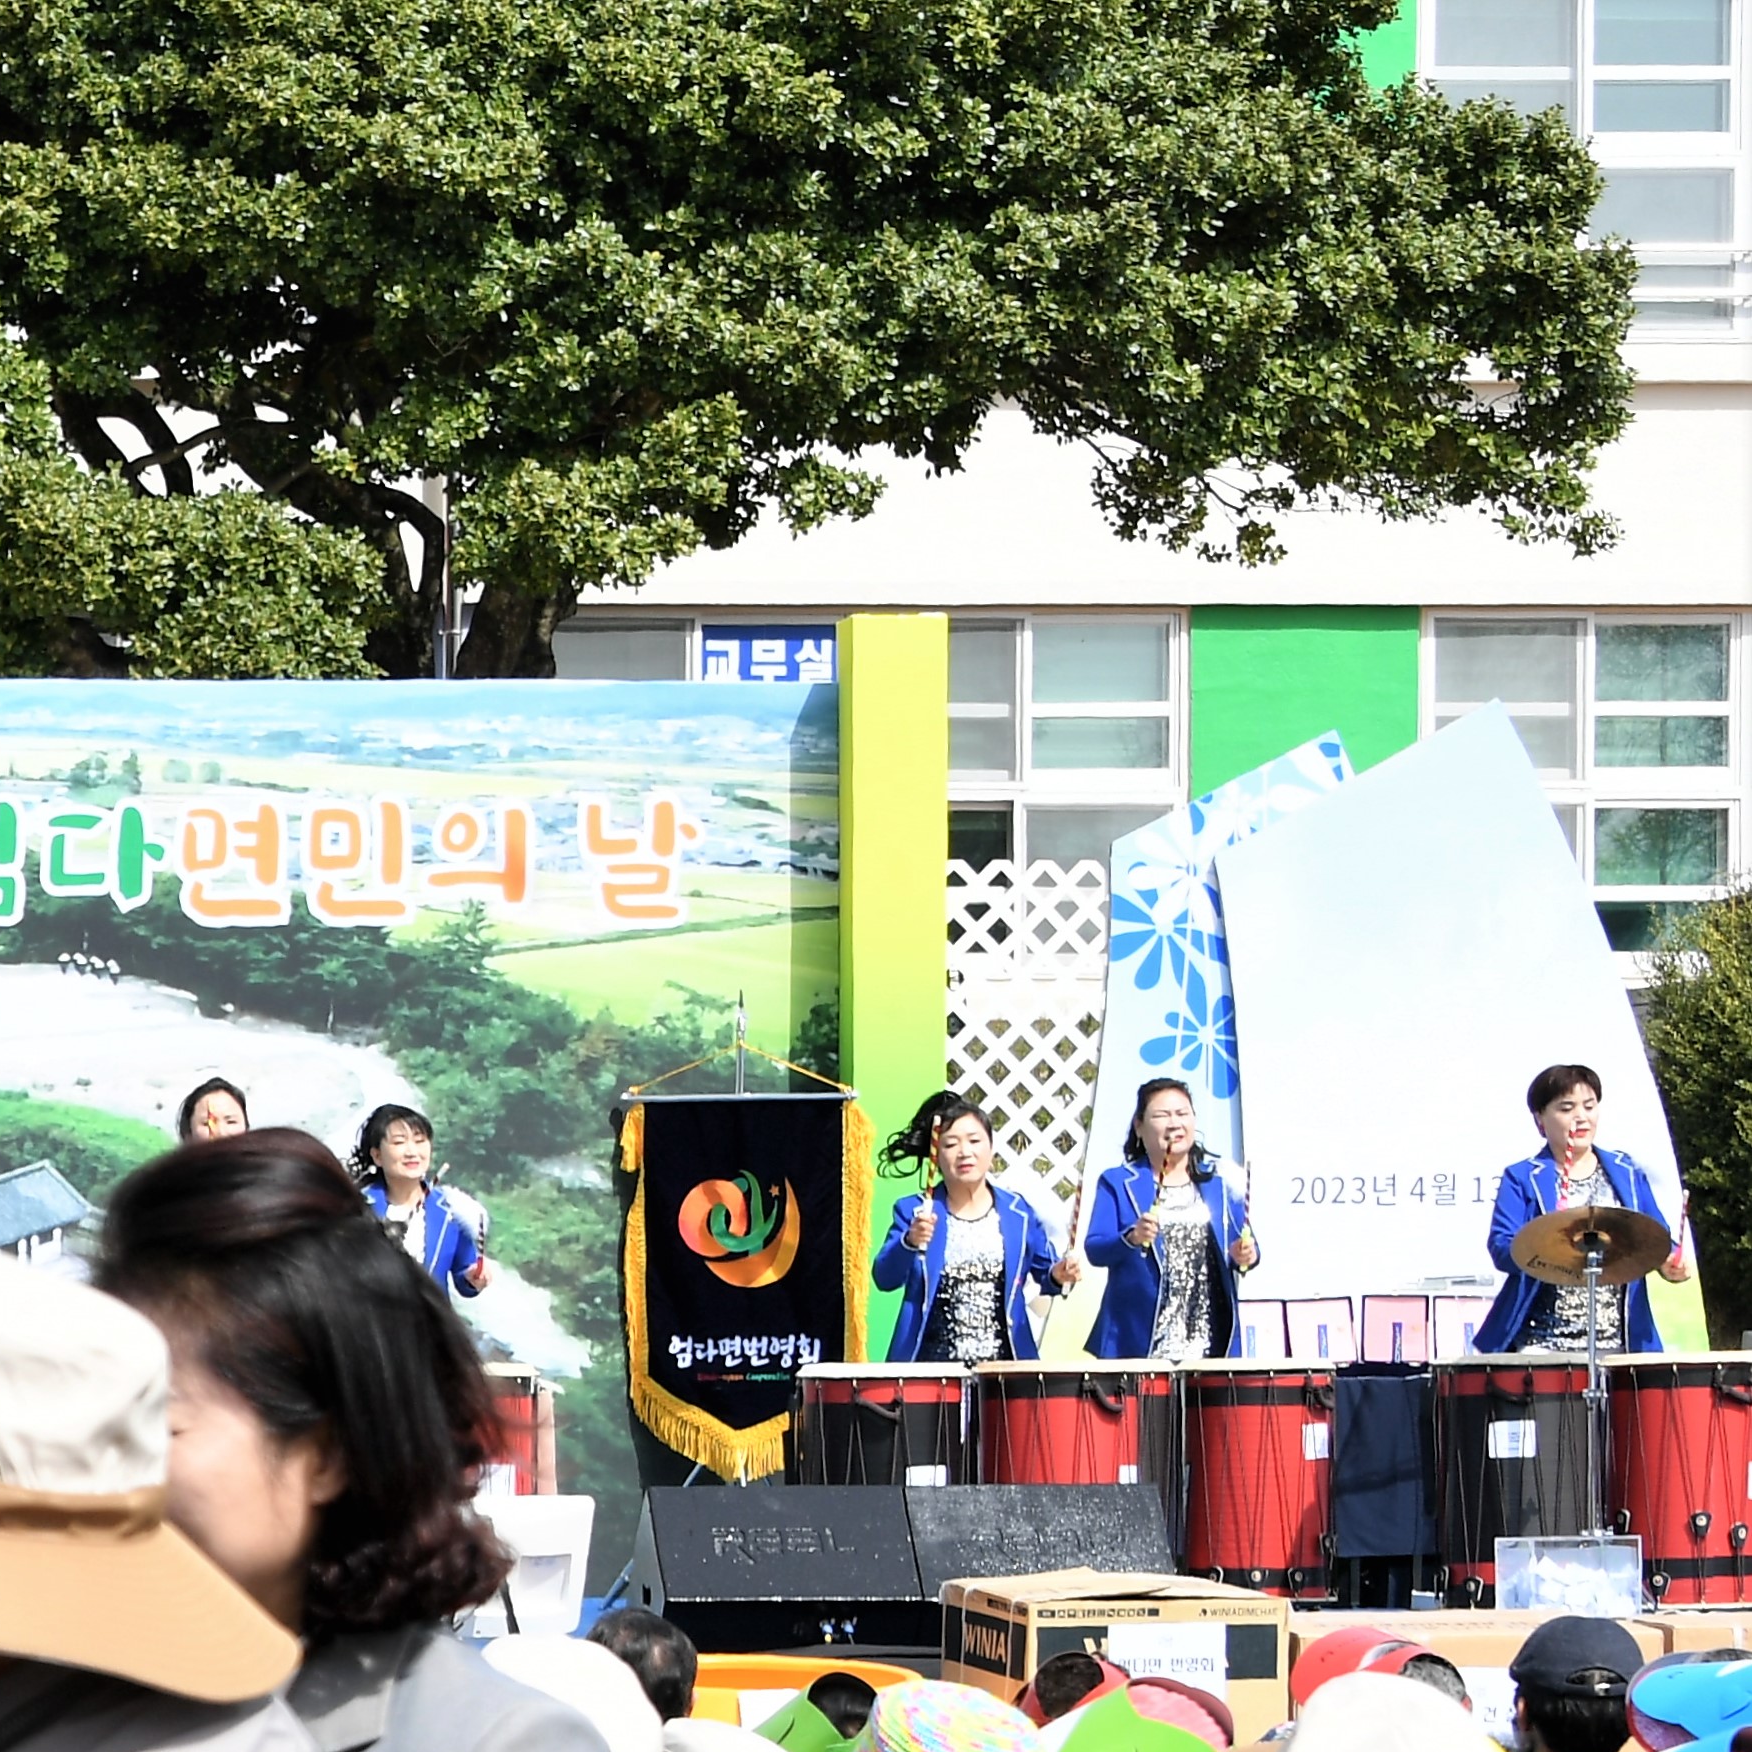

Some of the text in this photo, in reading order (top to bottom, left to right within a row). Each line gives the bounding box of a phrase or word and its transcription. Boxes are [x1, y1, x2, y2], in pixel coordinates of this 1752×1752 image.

[704, 639, 833, 683] 교무실
[586, 801, 701, 919] 날
[1291, 1173, 1396, 1206] 2023년
[1410, 1173, 1457, 1206] 4월
[668, 1333, 821, 1369] 엄다면번영회
[965, 1621, 1006, 1664] WINIA
